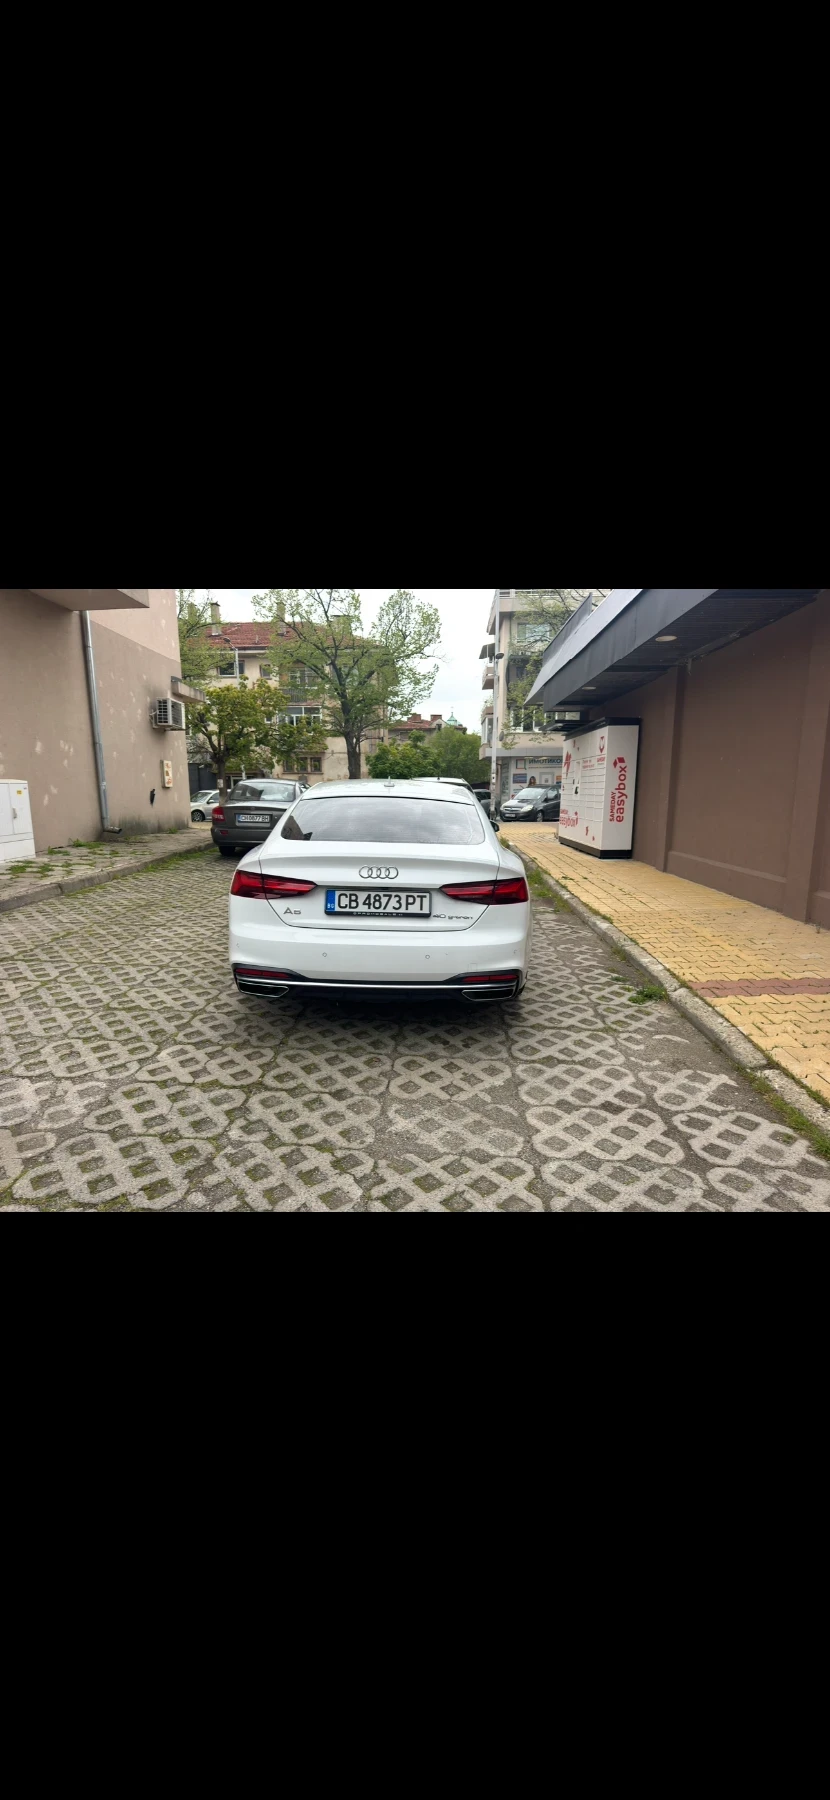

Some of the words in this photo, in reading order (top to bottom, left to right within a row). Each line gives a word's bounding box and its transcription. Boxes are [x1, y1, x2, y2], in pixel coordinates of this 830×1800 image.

[616, 765, 628, 822] easybox
[283, 906, 302, 915] A5
[338, 893, 359, 909] CB
[362, 894, 402, 910] 4873
[405, 894, 427, 911] PT
